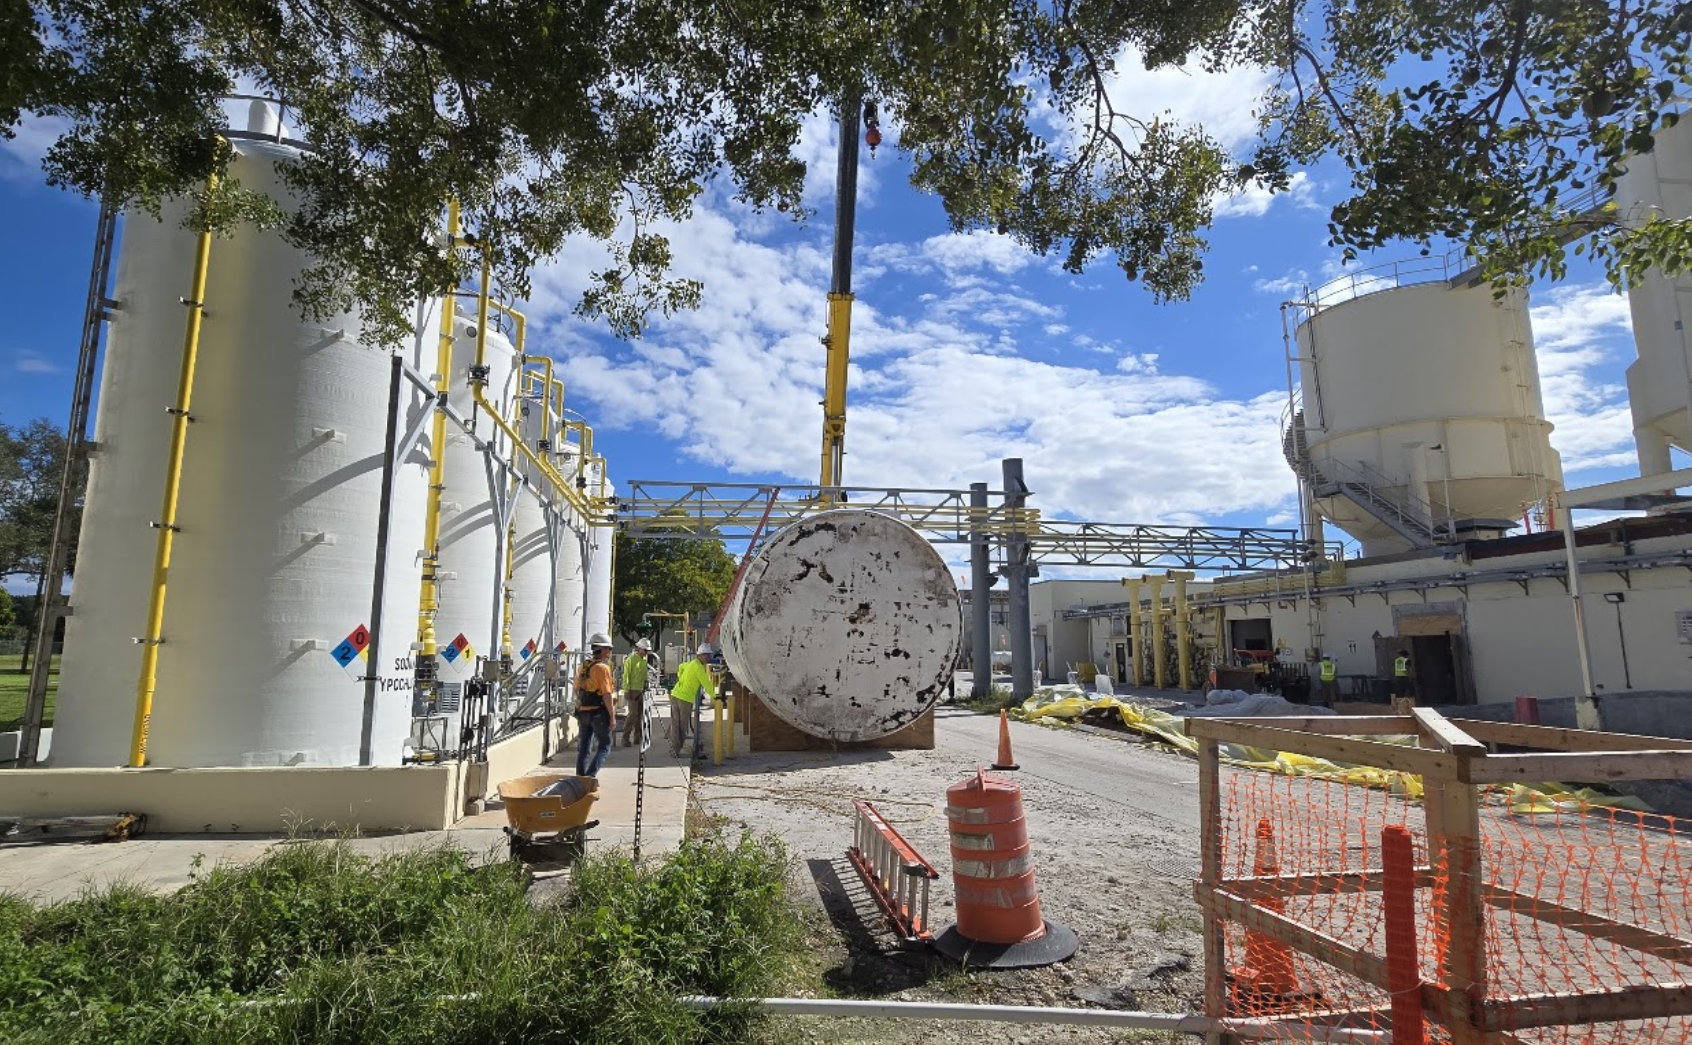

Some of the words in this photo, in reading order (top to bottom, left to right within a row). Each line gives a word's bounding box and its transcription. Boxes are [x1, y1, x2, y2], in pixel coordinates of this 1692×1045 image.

[355, 631, 366, 645] 0
[456, 638, 464, 648] 0
[340, 646, 351, 660] 2
[447, 647, 455, 658] 2
[465, 648, 470, 659] 1
